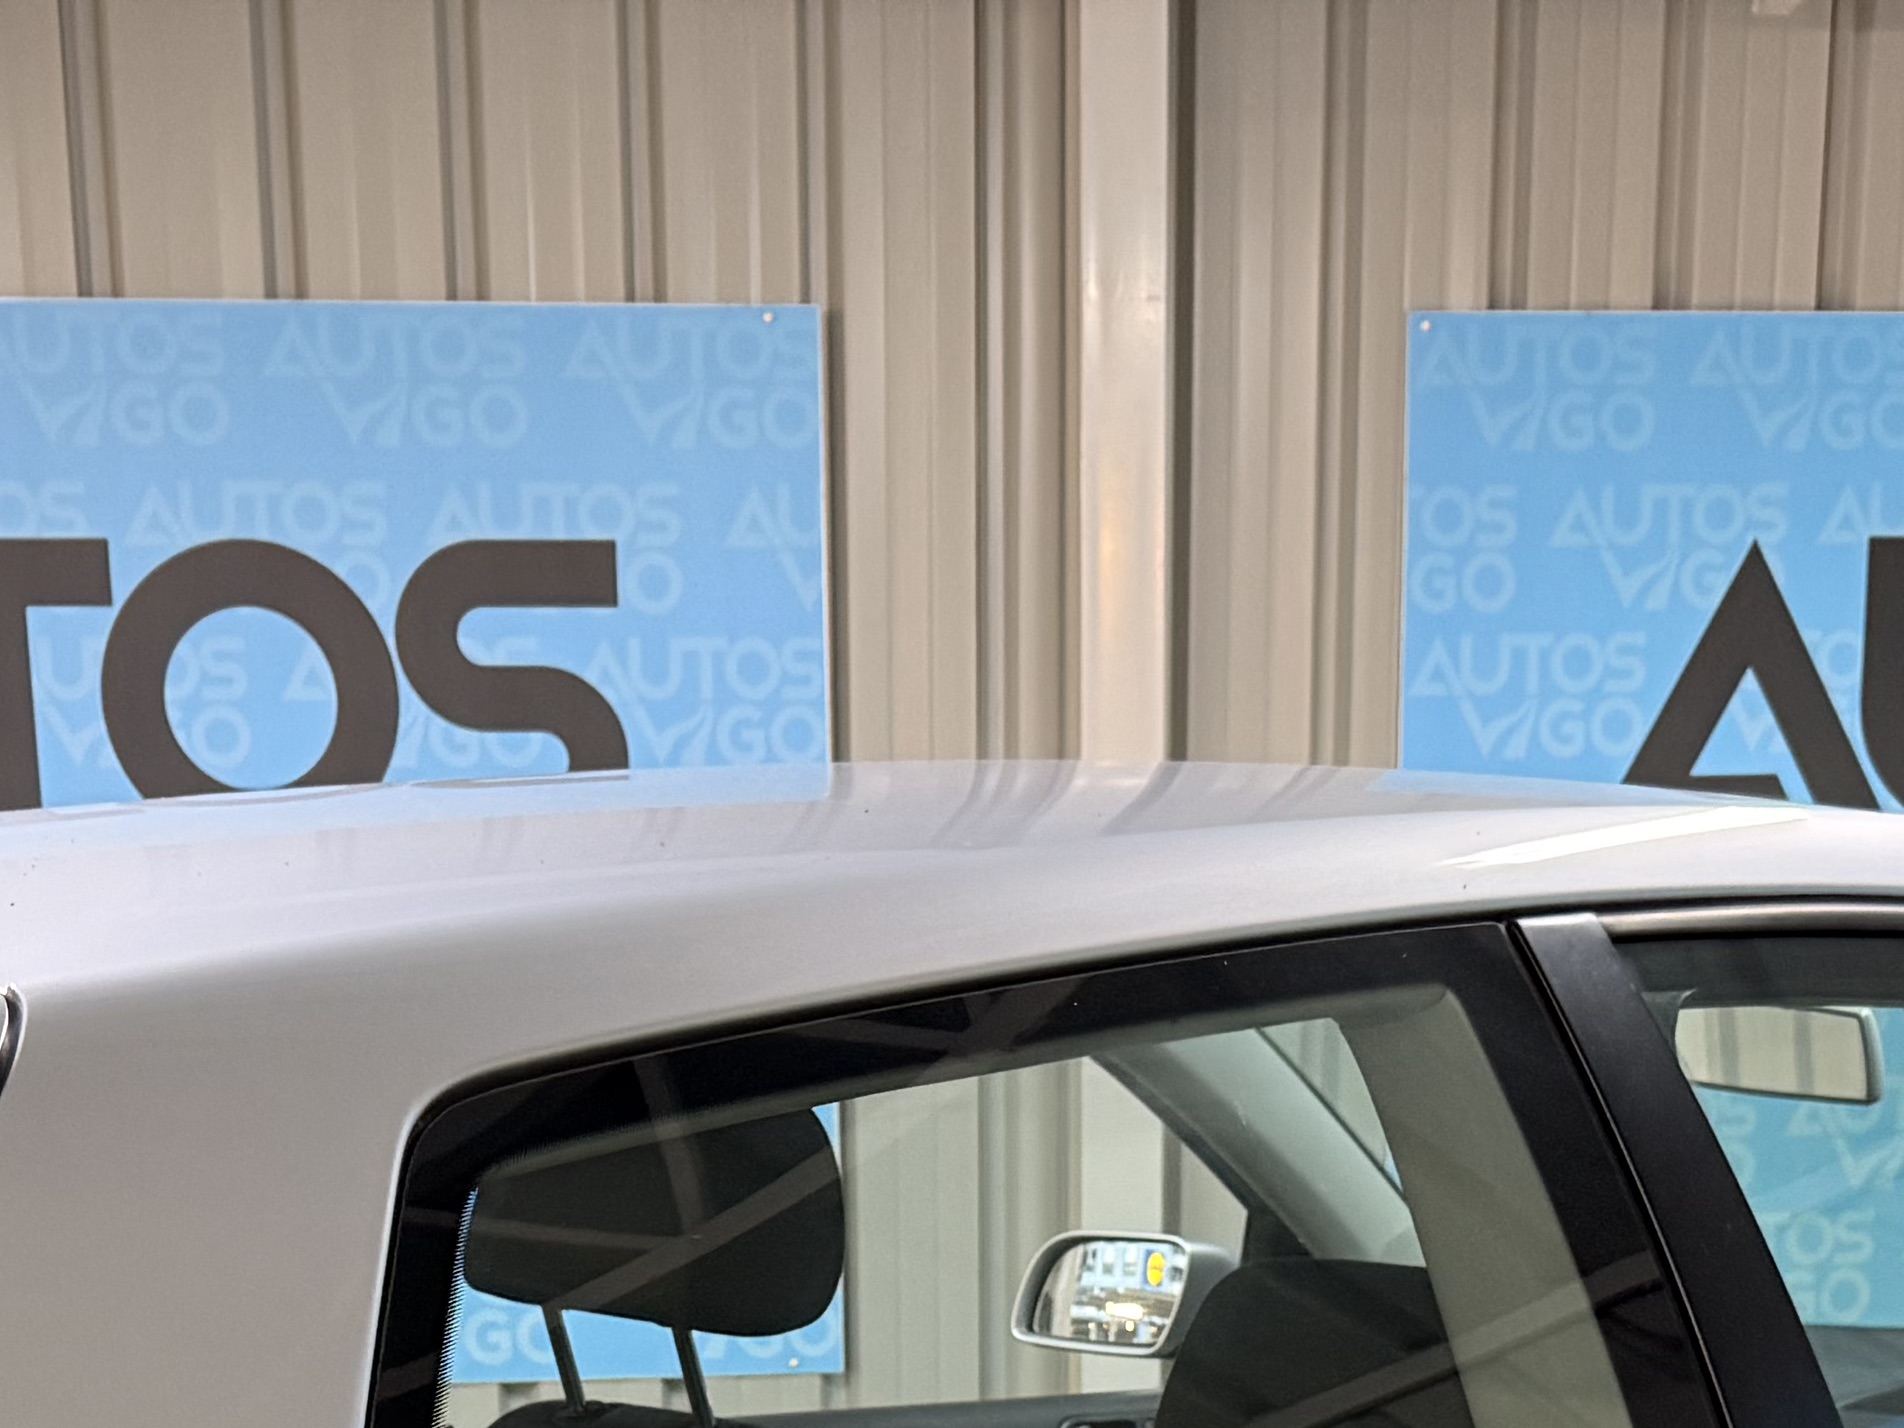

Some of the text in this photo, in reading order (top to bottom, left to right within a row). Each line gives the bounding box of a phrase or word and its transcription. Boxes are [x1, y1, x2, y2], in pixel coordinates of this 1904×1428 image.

[266, 315, 524, 377] AUTOS
[564, 315, 814, 378] AUTOS
[1416, 325, 1655, 384] AUTOS
[1469, 391, 1653, 450] VIGO
[1551, 484, 1787, 547] AUTOS
[1412, 632, 1643, 695] AUTOS
[1461, 698, 1642, 759] VIGO
